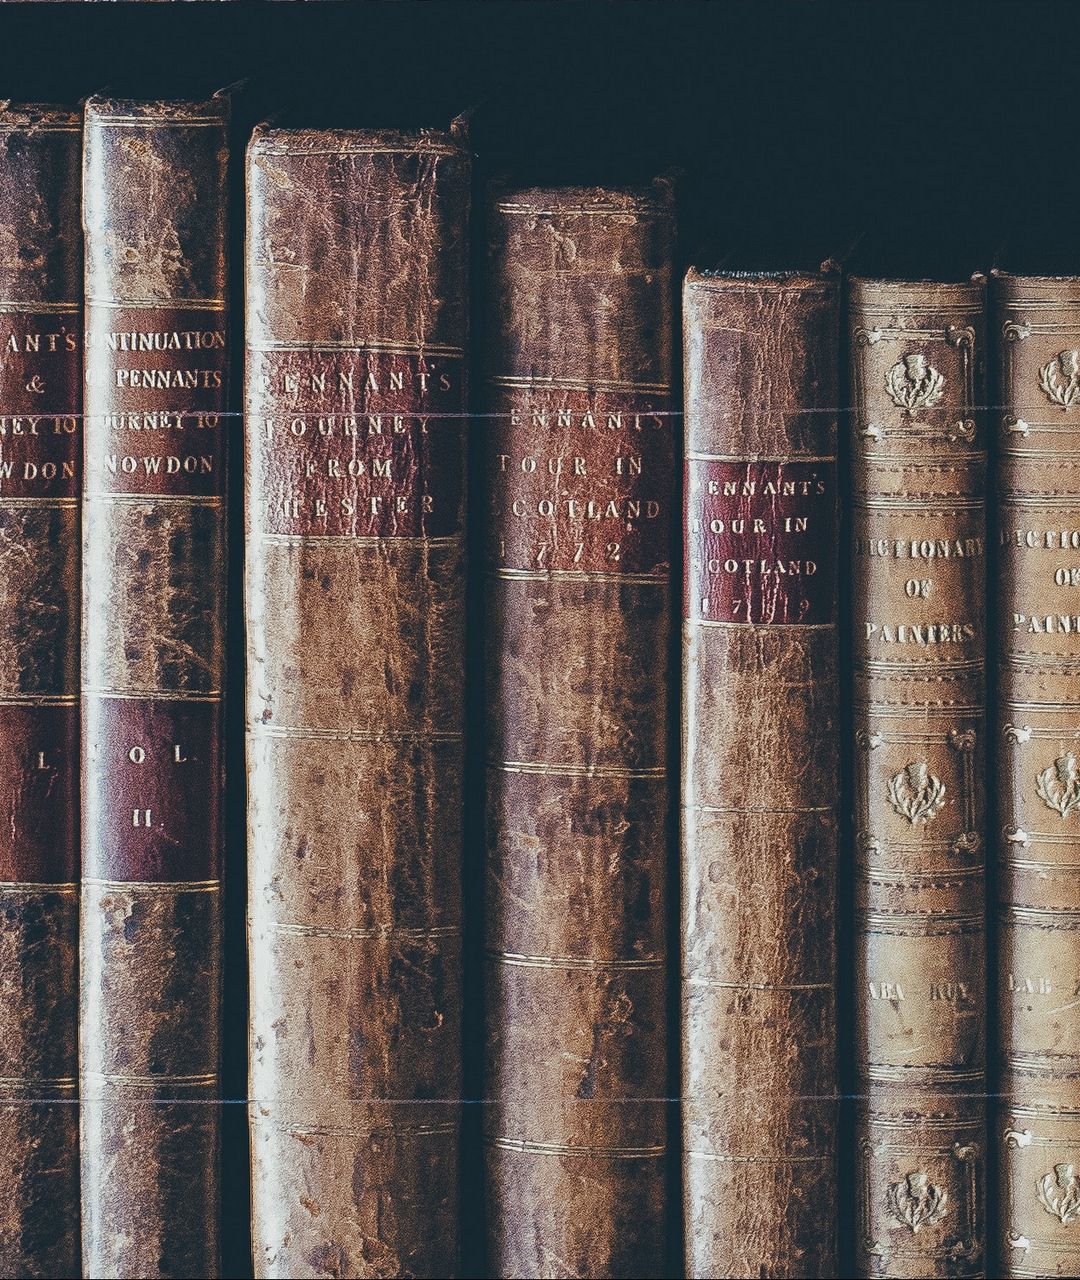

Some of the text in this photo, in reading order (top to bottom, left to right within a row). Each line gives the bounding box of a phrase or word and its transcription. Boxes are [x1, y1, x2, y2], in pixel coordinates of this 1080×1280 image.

[26, 375, 46, 394] &
[305, 458, 393, 479] FROM
[497, 453, 642, 476] TOUR IN
[784, 516, 808, 533] IN
[499, 540, 621, 563] 1772
[904, 578, 933, 599] OF
[865, 622, 975, 646] PAINTERS
